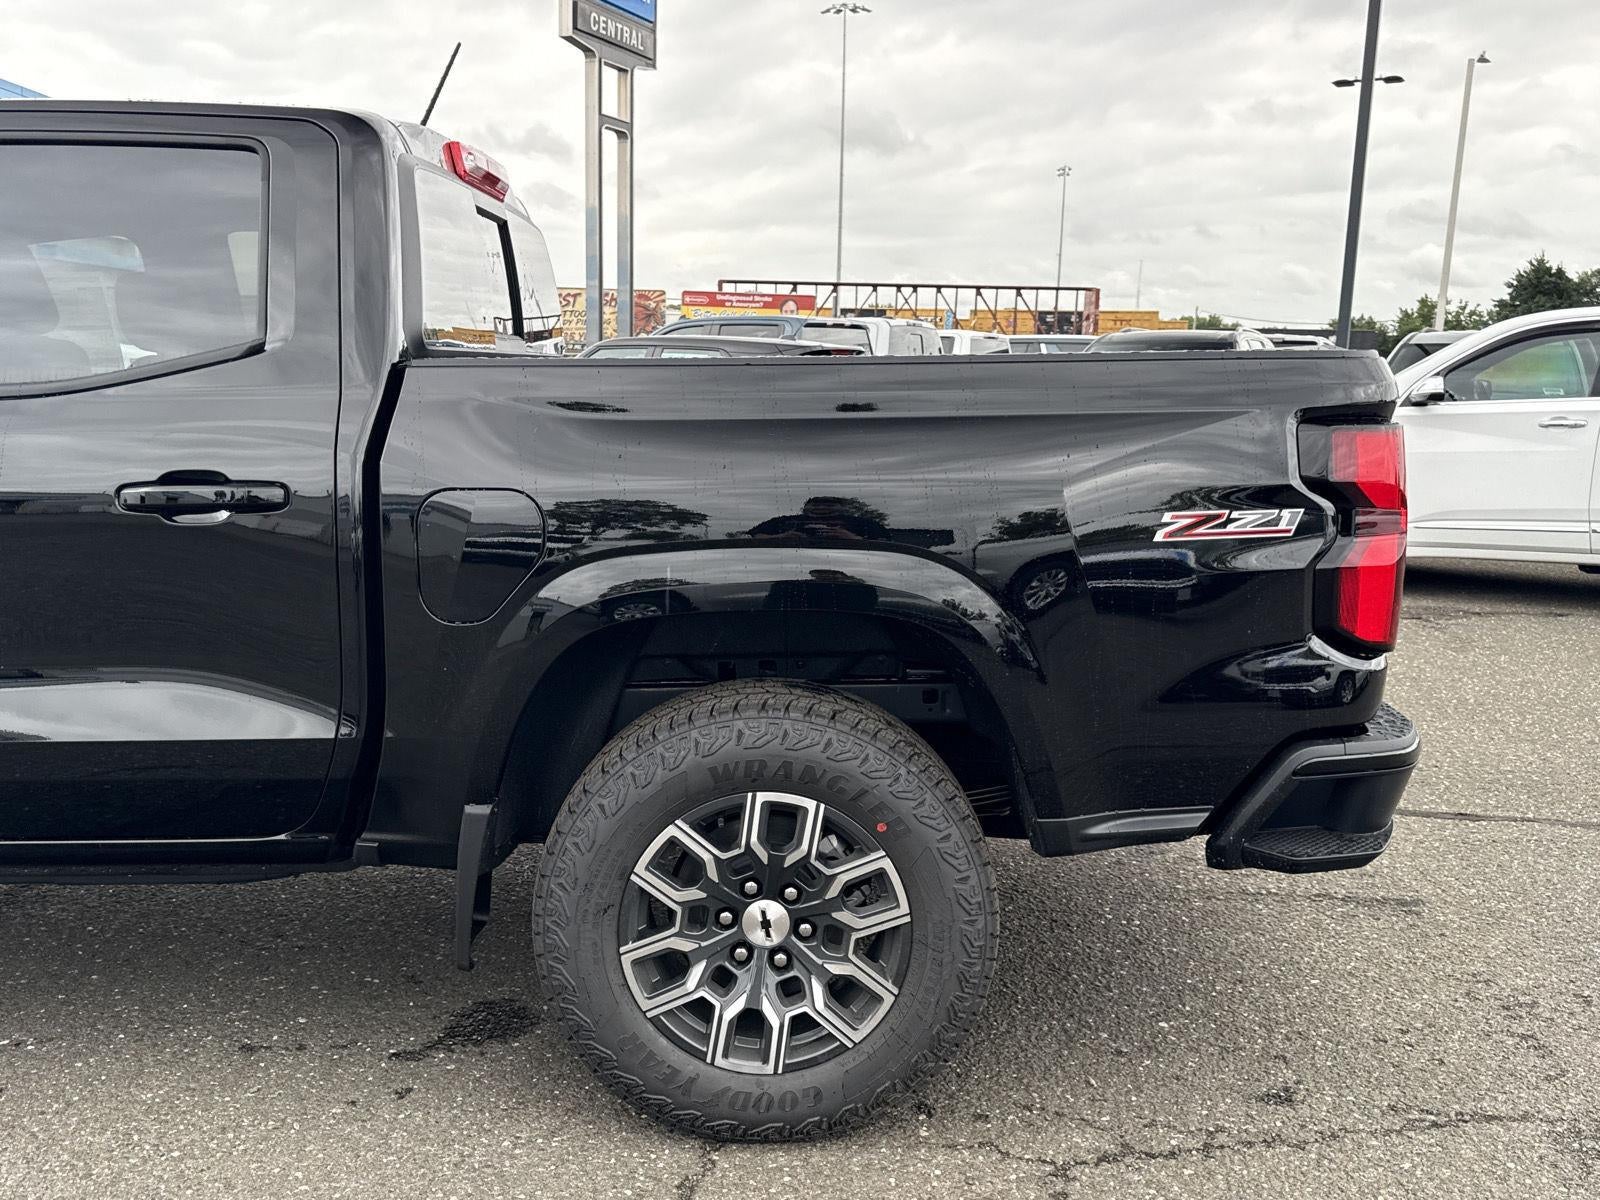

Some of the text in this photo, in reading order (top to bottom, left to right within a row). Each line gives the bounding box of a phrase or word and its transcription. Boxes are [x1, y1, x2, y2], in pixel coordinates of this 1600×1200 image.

[590, 12, 644, 50] CENTRAL
[1152, 508, 1305, 542] Z71
[707, 759, 913, 840] WRANGLER
